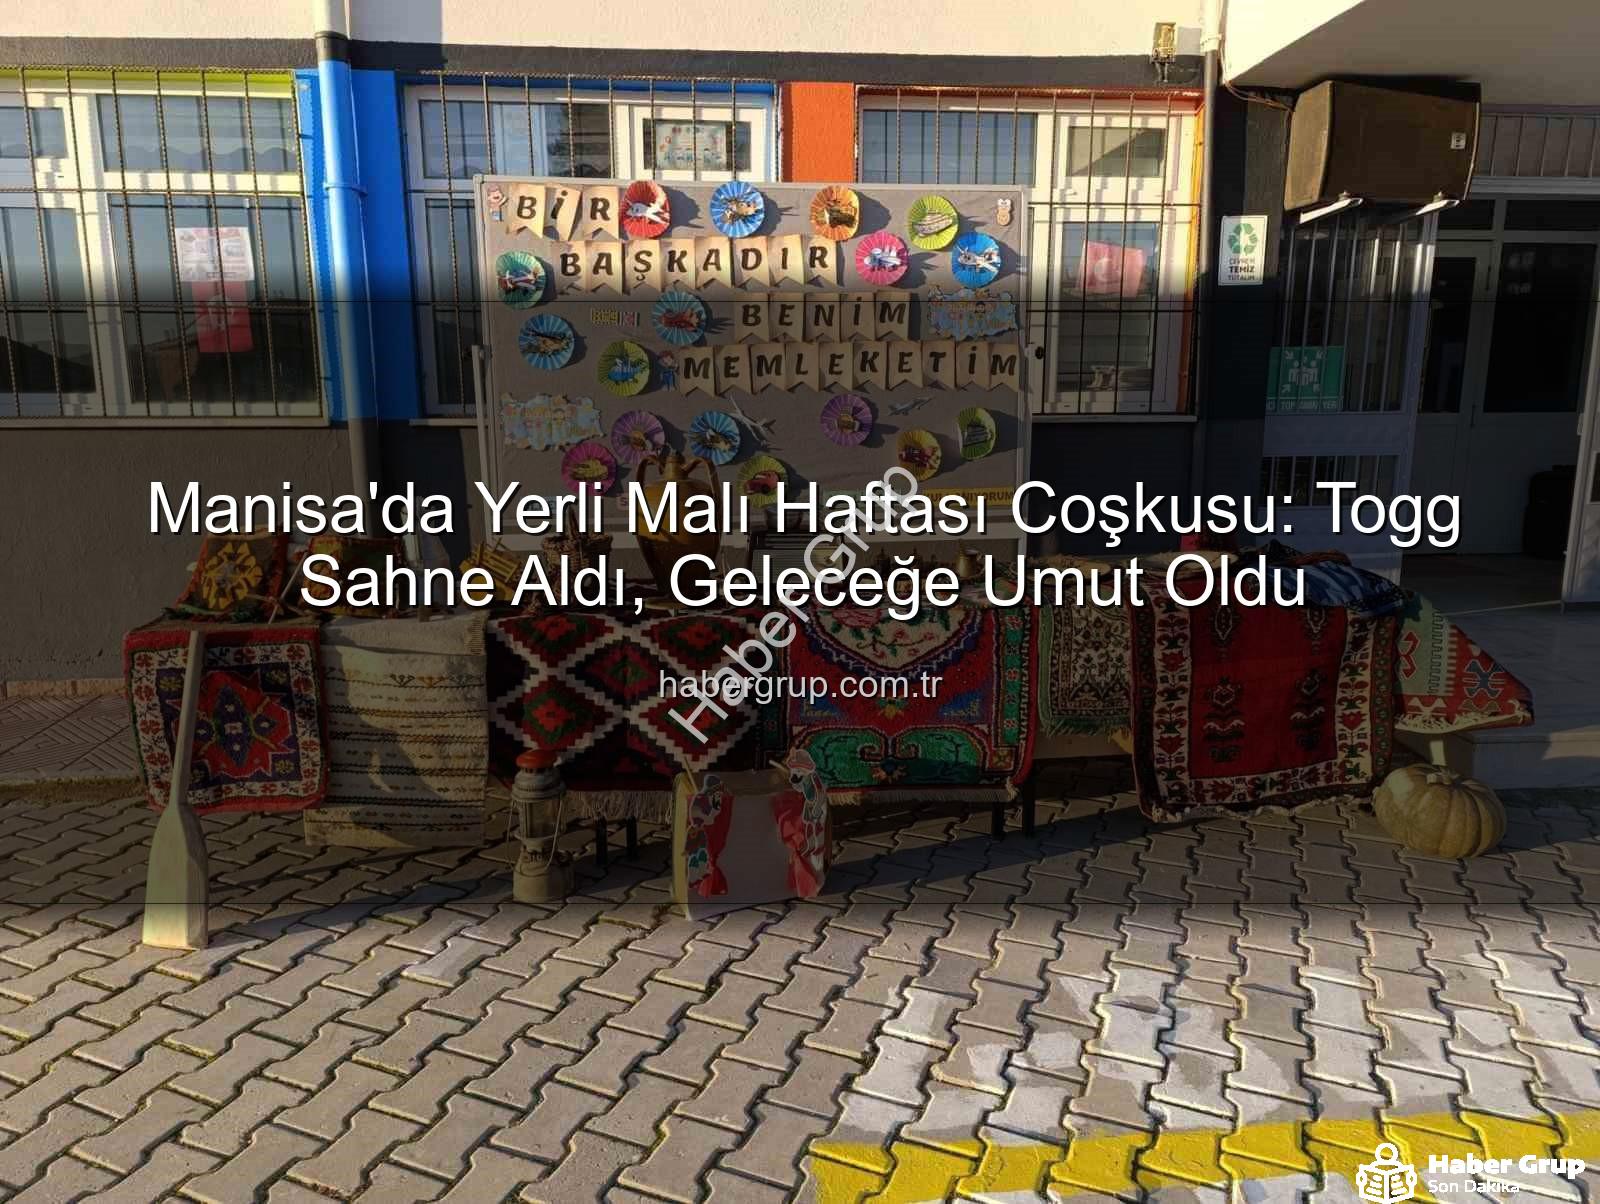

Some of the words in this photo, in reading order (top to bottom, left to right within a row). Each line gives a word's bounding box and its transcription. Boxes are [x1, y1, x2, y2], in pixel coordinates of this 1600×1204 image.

[515, 190, 611, 222] BİR
[559, 245, 829, 282] BAŞKADIR
[741, 296, 906, 327] BENİM
[682, 346, 1017, 380] MEMLEKETİM
